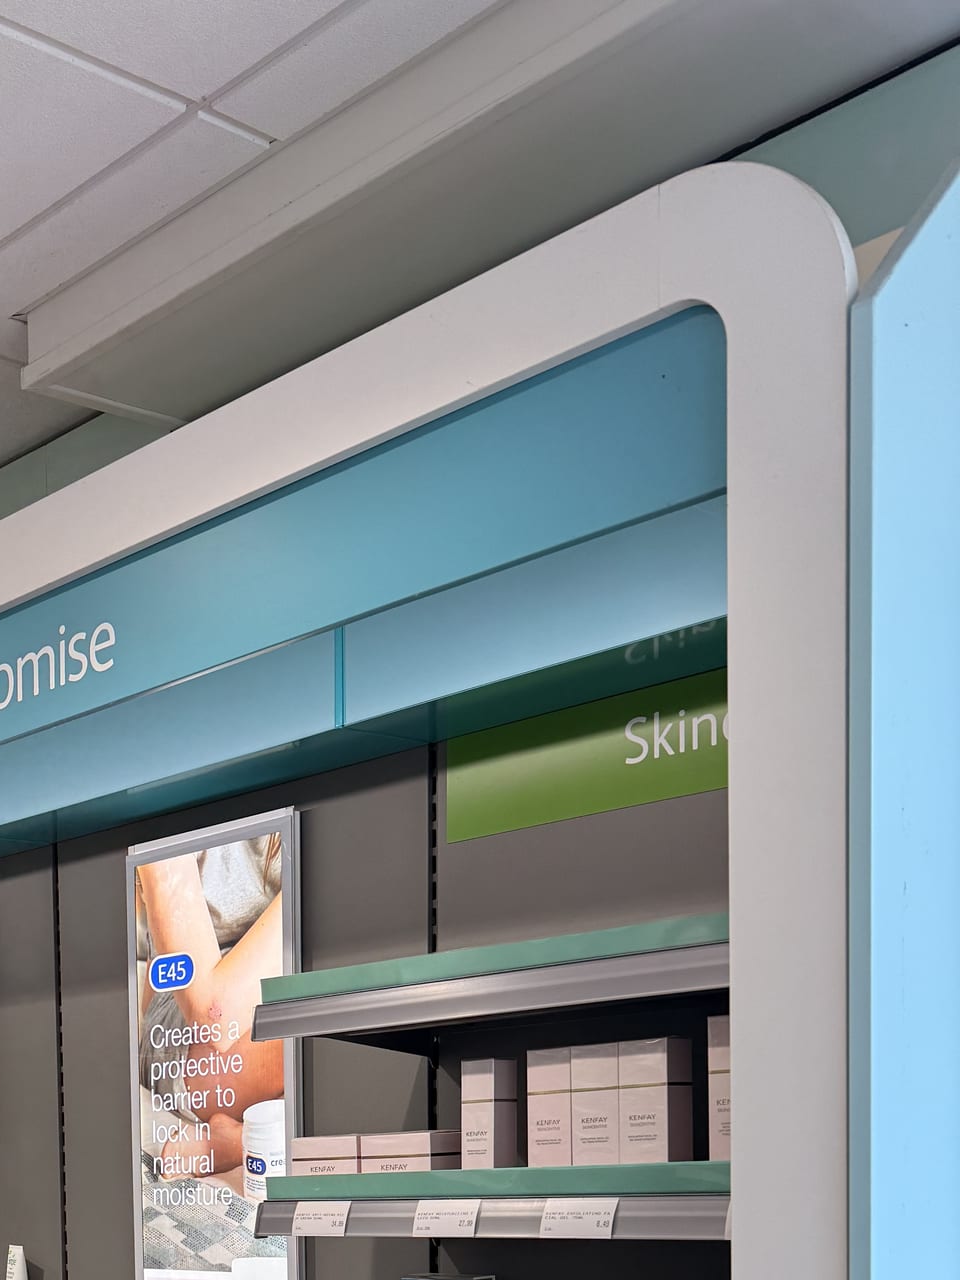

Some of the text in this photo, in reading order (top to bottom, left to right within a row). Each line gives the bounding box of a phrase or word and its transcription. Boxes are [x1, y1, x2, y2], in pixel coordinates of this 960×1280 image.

[158, 960, 187, 984] E45
[150, 1020, 240, 1050] Creates a
[150, 1050, 244, 1088] protective
[151, 1086, 236, 1112] barrier to
[581, 1116, 608, 1124] KENFAY
[629, 1113, 656, 1121] KENFAY
[152, 1119, 211, 1144] lock in
[152, 1149, 215, 1176] natural
[247, 1157, 264, 1173] E45
[270, 1156, 286, 1168] cre
[380, 1163, 408, 1171] KENFAY
[152, 1182, 234, 1207] moisture
